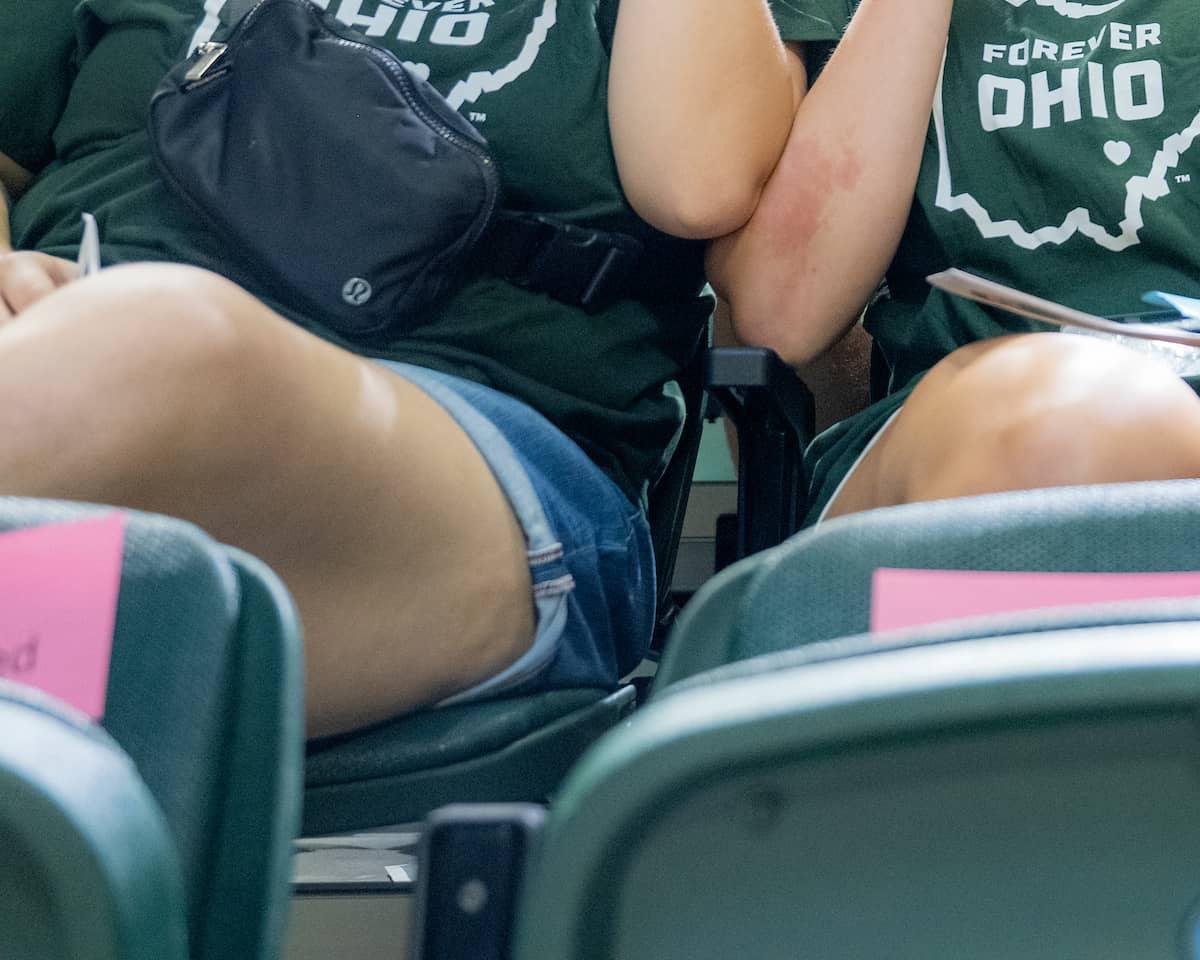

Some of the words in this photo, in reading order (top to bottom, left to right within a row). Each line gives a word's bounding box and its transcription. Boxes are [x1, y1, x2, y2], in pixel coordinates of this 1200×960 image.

[983, 22, 1161, 66] FOREVER
[978, 59, 1165, 132] OHIO
[1174, 174, 1191, 183] TM
